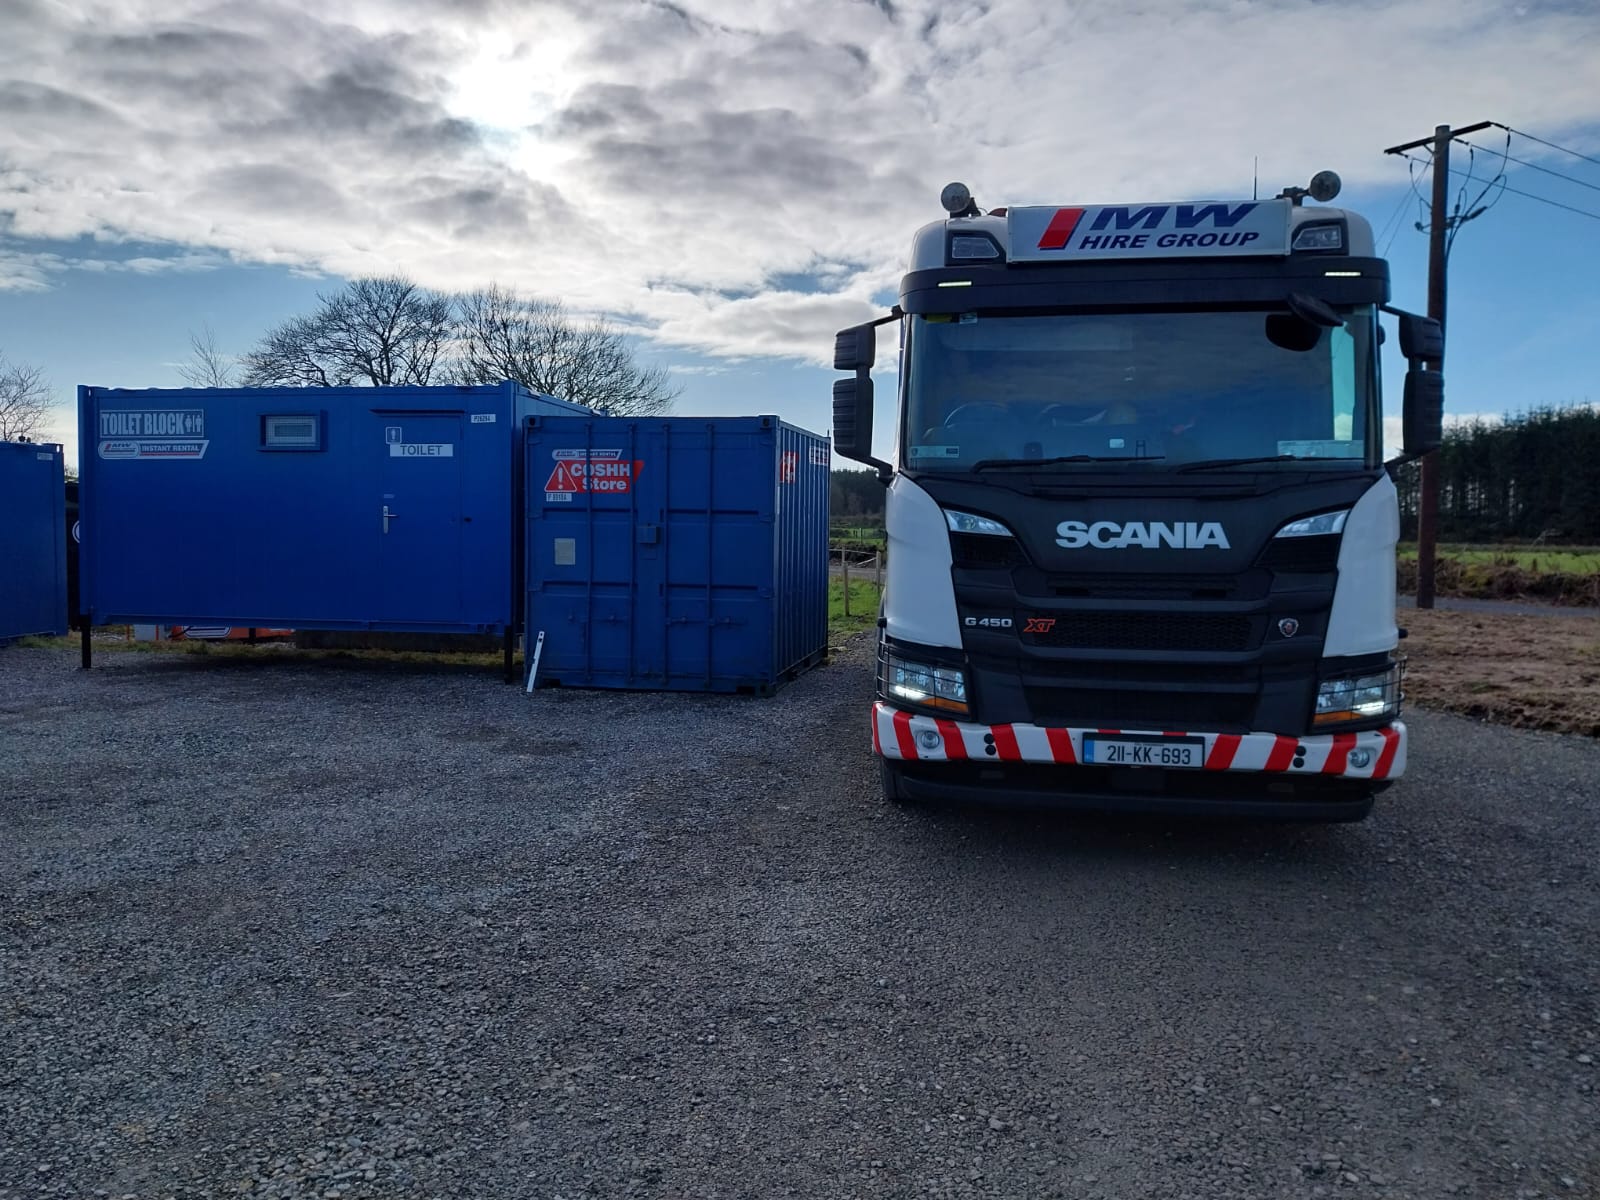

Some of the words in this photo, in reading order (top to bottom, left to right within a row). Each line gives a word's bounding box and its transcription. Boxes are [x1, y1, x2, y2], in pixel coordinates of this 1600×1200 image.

[1089, 203, 1260, 230] MW
[1078, 234, 1150, 249] HIRE
[1156, 232, 1260, 248] GROUP
[101, 413, 142, 435] TOILET
[144, 413, 185, 435] BLOCK
[400, 445, 443, 456] TOILET
[570, 463, 630, 477] COSHH
[582, 477, 627, 490] Store
[1055, 520, 1232, 550] SCANIA
[1023, 619, 1056, 632] XT
[1107, 744, 1192, 765] 211-KK-693
